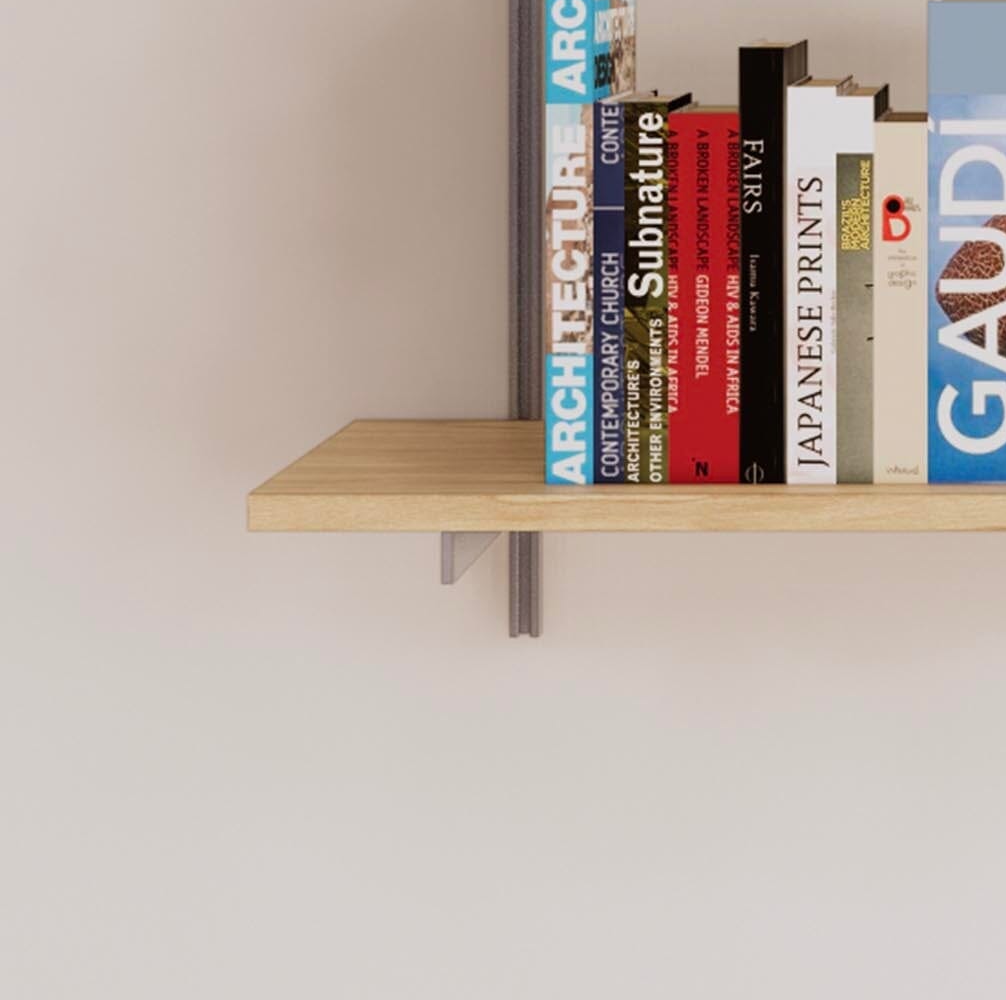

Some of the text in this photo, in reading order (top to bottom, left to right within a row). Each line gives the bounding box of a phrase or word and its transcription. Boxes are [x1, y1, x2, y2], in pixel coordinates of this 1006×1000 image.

[627, 111, 665, 298] Subnature
[695, 142, 710, 193] BROKEN
[742, 139, 764, 214] FAIRS
[860, 159, 871, 250] ARCHITECTURE
[695, 197, 710, 271] LANDSCAPE
[841, 199, 851, 250] BRAZIL'S
[850, 197, 861, 250] MODERN
[551, 123, 589, 485] ARCHITECTURE
[695, 274, 710, 324] GIDEON
[726, 274, 740, 299] HIV
[797, 176, 830, 468] JAPANESE PRINTS
[600, 252, 621, 478] CONTEMPORARY CHURCH
[695, 327, 710, 379] MENDEL
[726, 315, 740, 347] AIDS
[627, 359, 640, 483] ARCHITECTURE'S
[649, 317, 664, 483] OTHER ENVIRONMENTS
[726, 367, 740, 414] AFRICA
